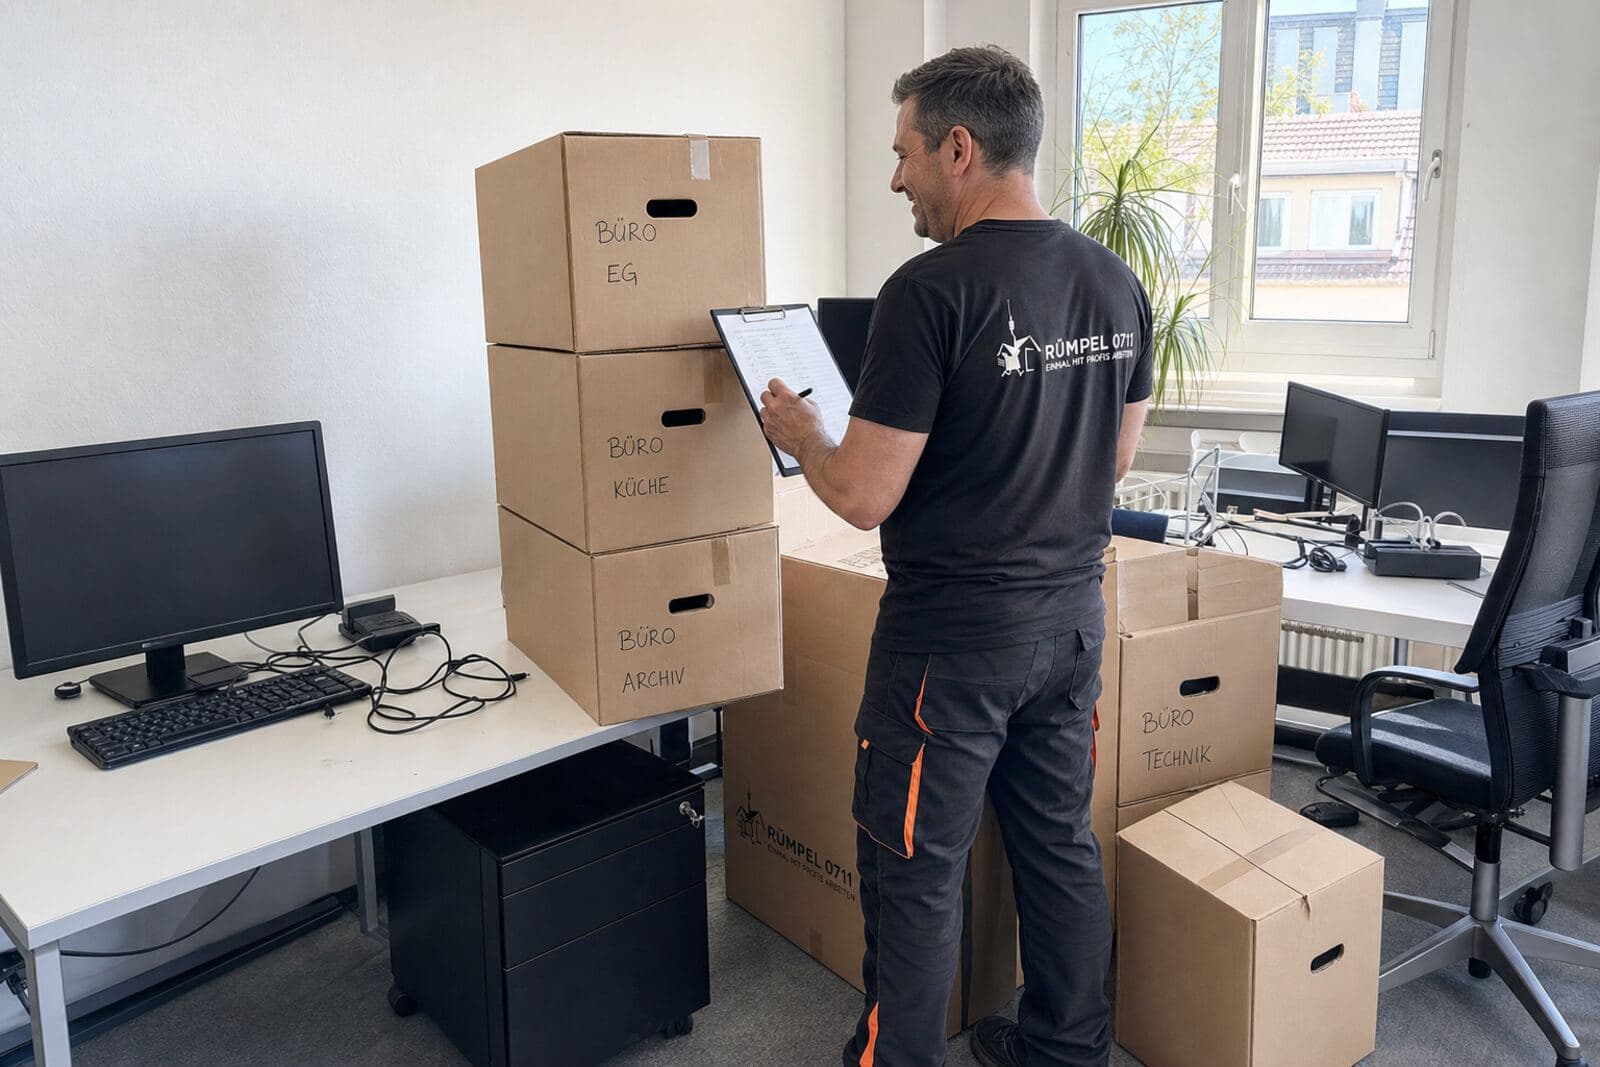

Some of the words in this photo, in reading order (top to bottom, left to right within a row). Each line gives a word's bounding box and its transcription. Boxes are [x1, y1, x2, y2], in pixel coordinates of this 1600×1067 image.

[595, 217, 656, 243] BÜRO
[608, 263, 637, 286] EG
[1045, 335, 1109, 360] RÜMPEL
[1112, 333, 1134, 349] 0711
[608, 435, 663, 458] BÜRO
[614, 475, 669, 499] KÜCHE
[618, 625, 675, 651] BÜRO
[622, 666, 685, 693] ARCHIV
[1142, 706, 1194, 734] BÜRO
[1142, 744, 1211, 771] TECHNIK
[767, 825, 822, 869] RÜMPEL
[825, 859, 852, 888] 0711
